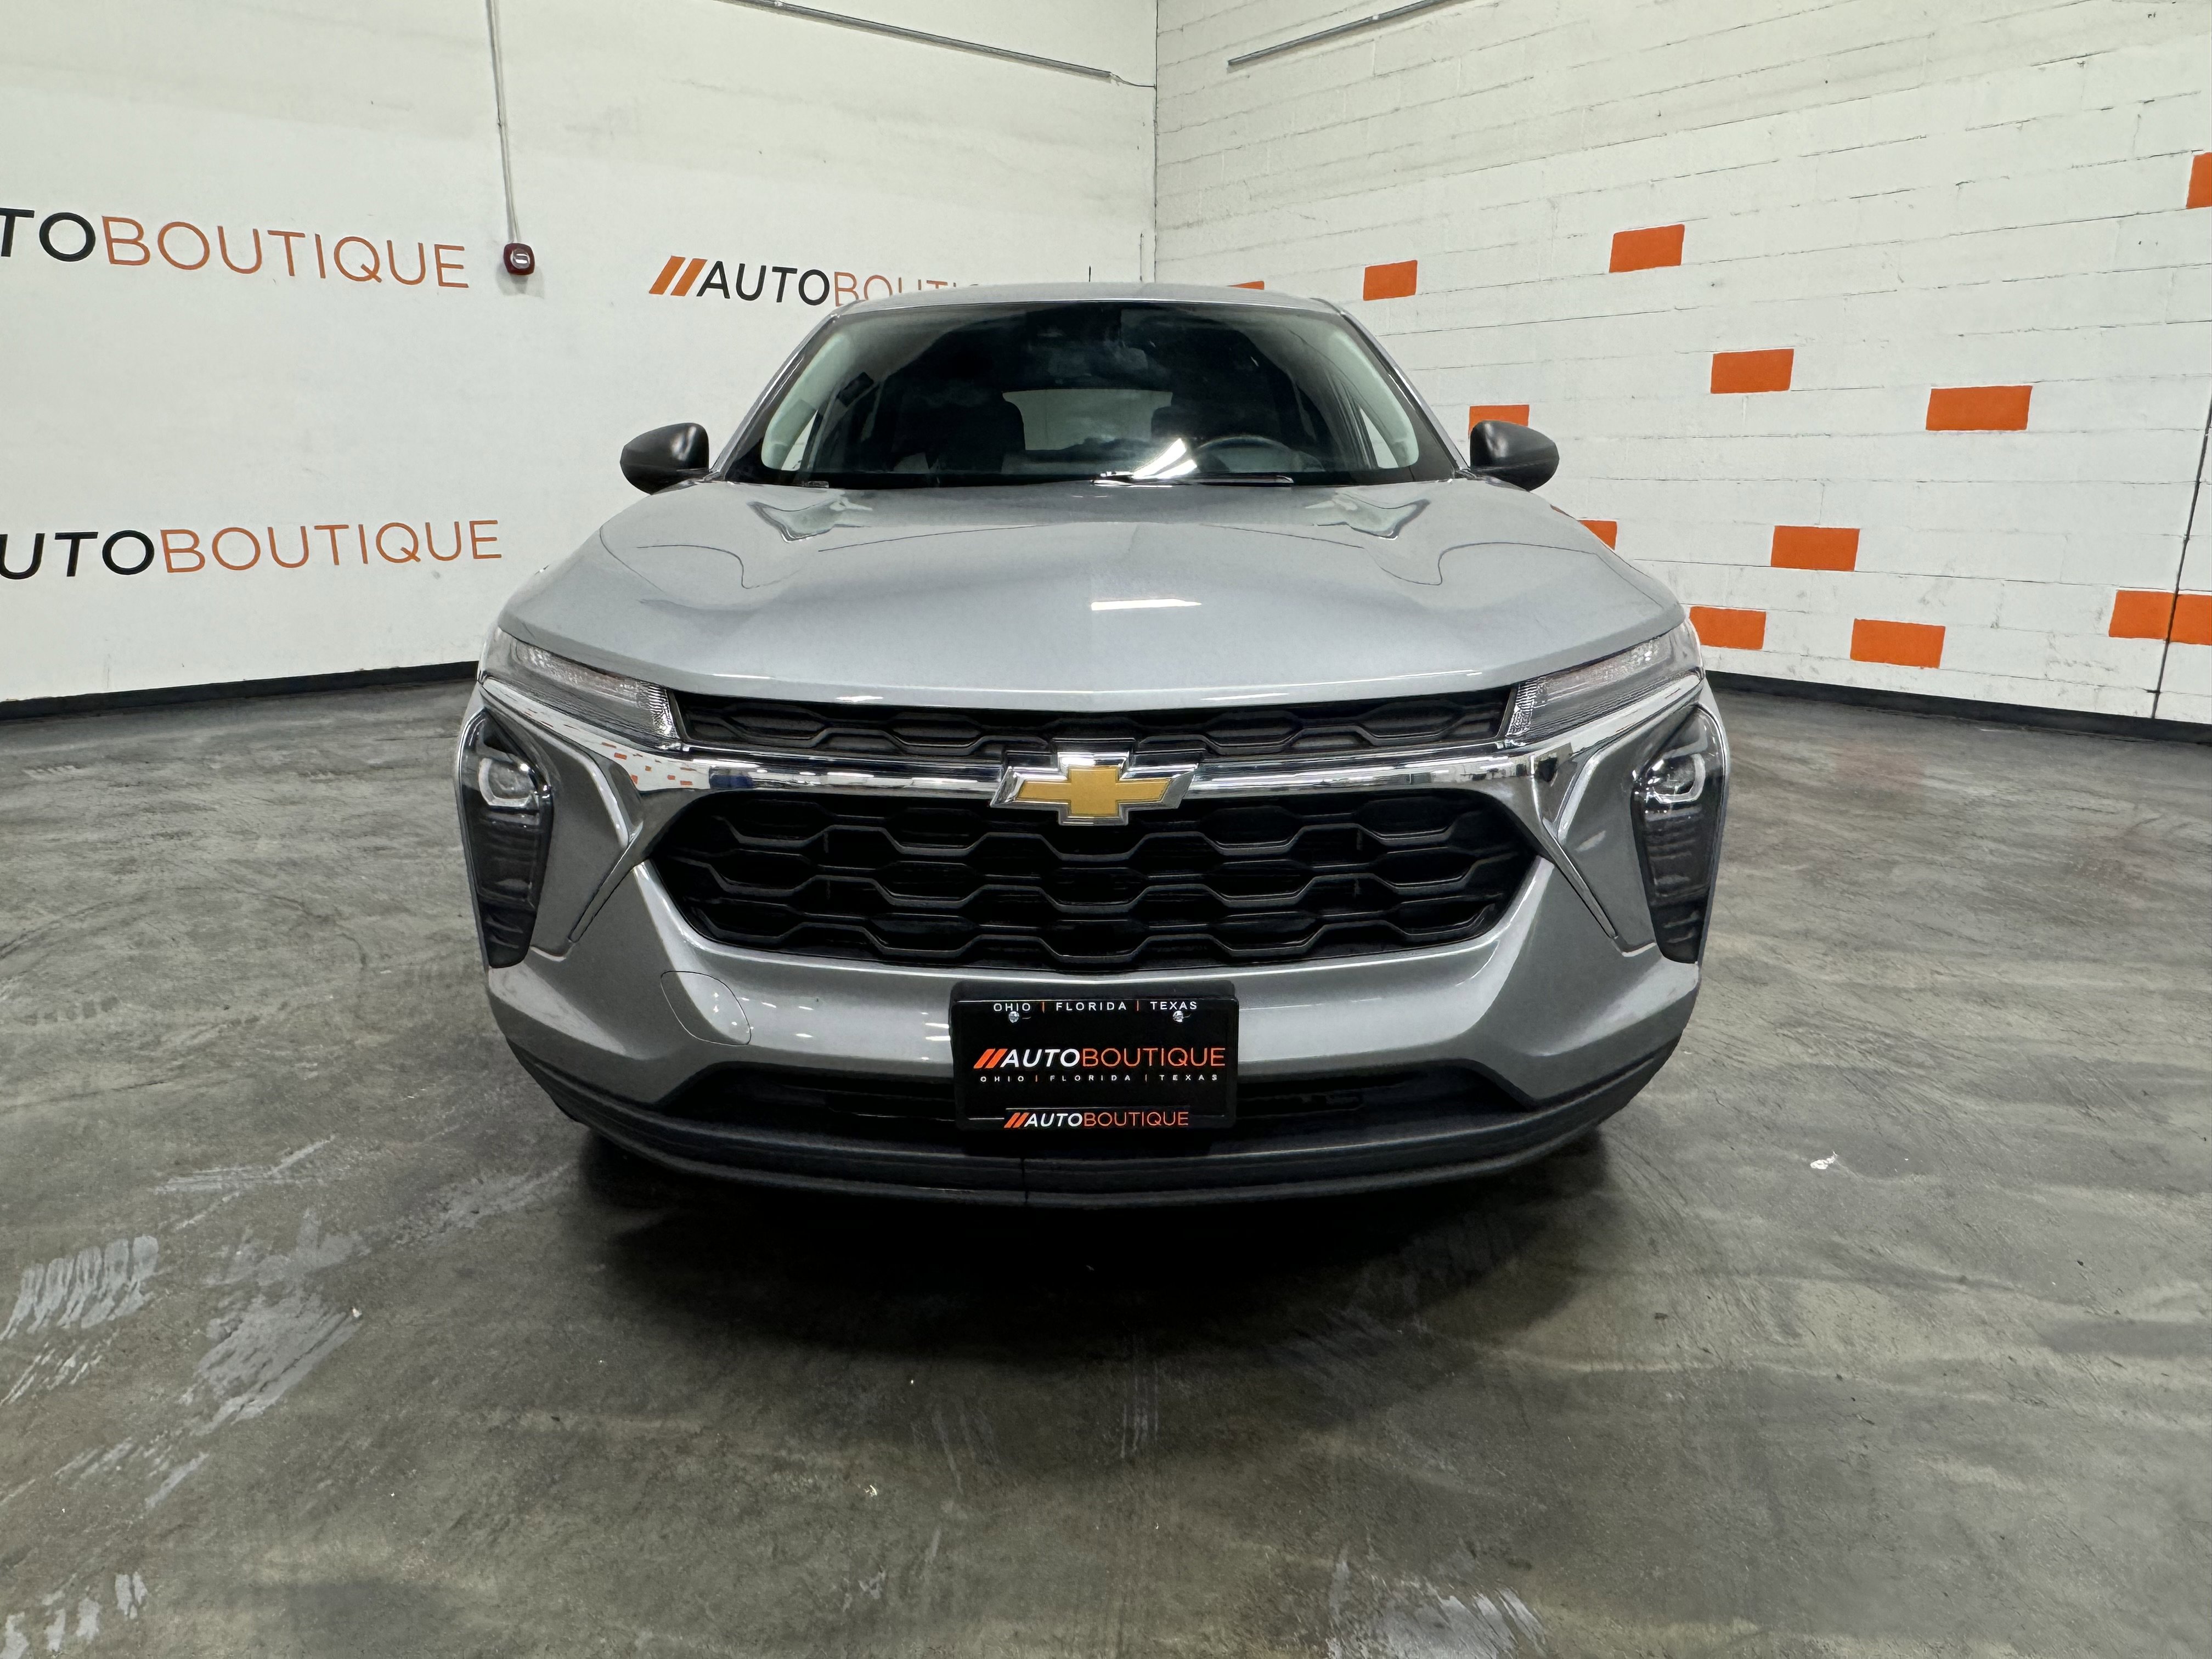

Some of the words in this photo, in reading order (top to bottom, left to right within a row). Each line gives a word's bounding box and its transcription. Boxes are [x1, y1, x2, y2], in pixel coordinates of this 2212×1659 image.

[993, 1002, 1031, 1012] OHIO
[1056, 1002, 1127, 1011] FLORIDA
[1150, 1001, 1197, 1010] TEXAS
[1000, 1047, 1226, 1068] AUTOBOUTIQUE
[1024, 1111, 1189, 1127] AUTOBOUTIQUE
